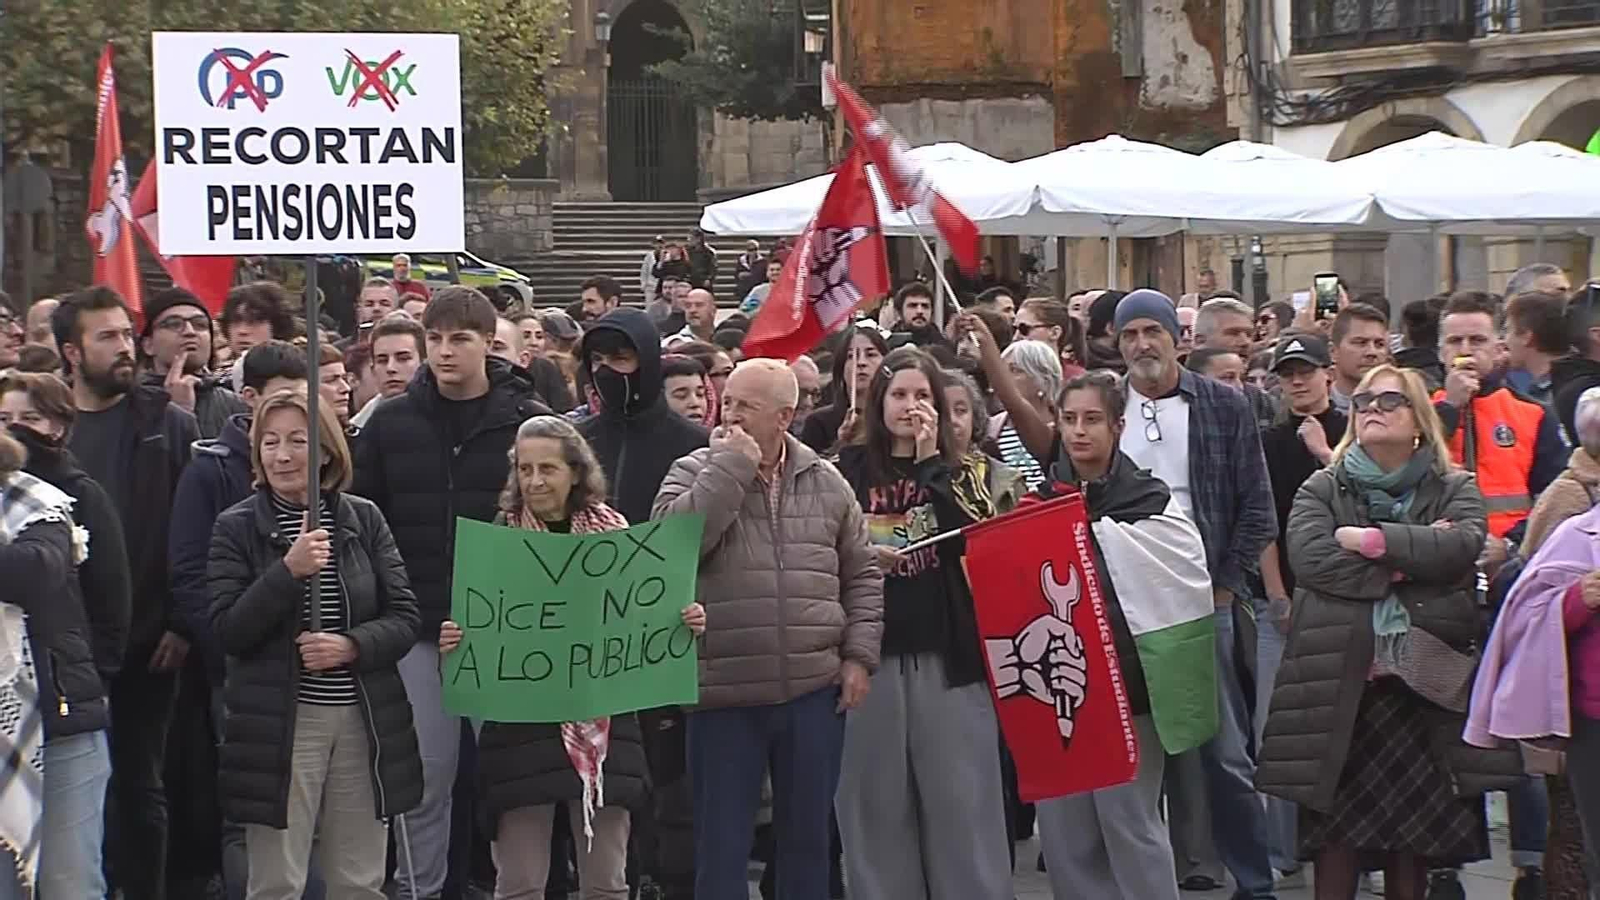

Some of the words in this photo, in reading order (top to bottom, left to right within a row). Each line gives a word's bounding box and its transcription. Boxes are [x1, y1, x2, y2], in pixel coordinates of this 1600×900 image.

[325, 57, 418, 101] VOX
[163, 126, 456, 165] RECORTAN
[206, 182, 417, 241] PENSIONES
[523, 522, 666, 585] VOX
[602, 576, 666, 624] NO
[452, 645, 481, 689] A
[497, 645, 553, 682] LO
